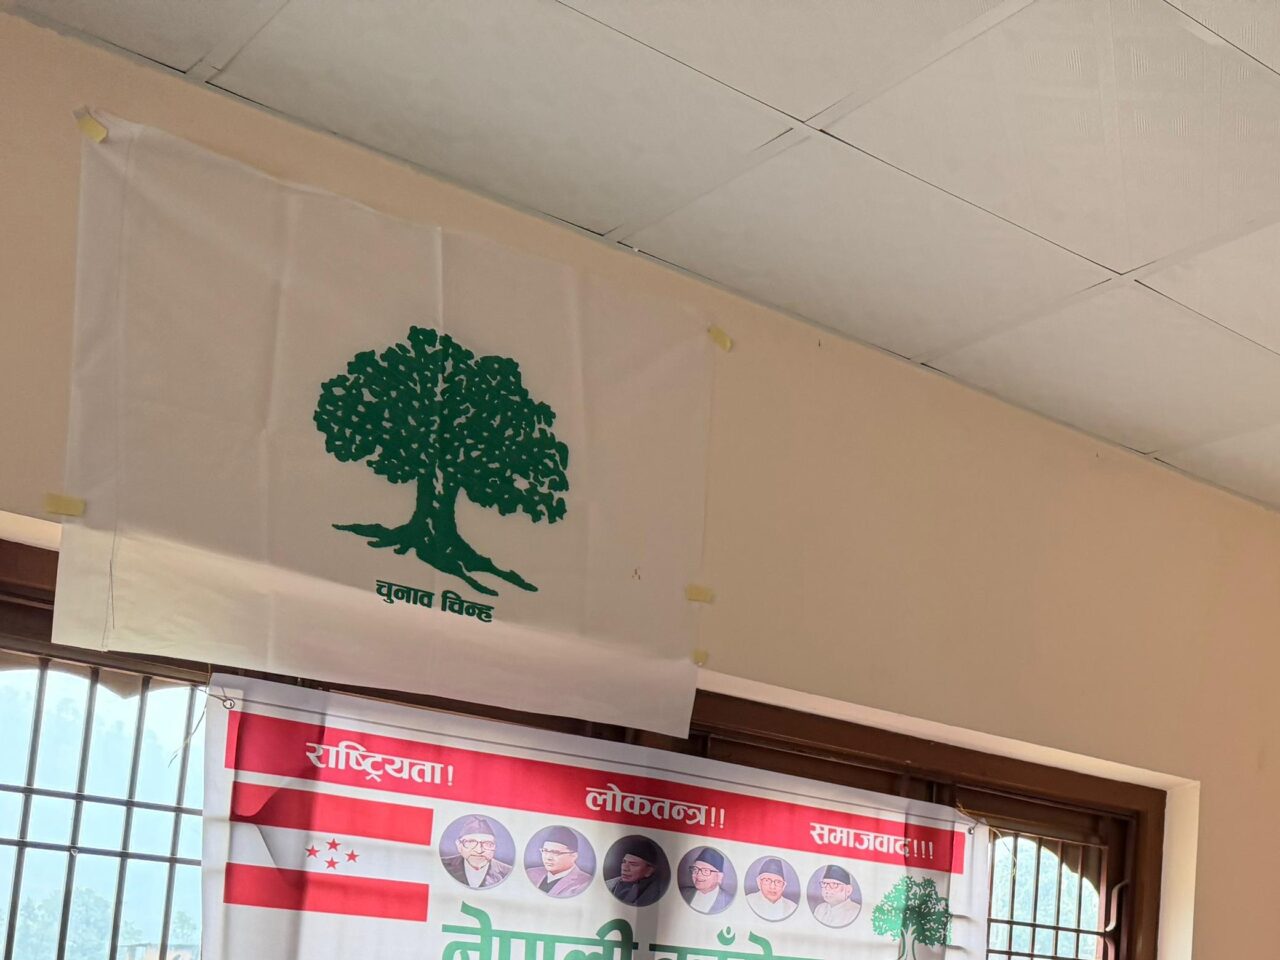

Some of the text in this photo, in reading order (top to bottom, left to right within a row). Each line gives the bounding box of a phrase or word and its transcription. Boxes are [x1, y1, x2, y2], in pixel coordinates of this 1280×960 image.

[375, 579, 496, 623] चुनाव चिन्ह
[305, 740, 457, 787] राष्ट्रियता!
[584, 783, 727, 830] लोकतन्त्र!!
[809, 821, 935, 860] समाजवाद!!!
